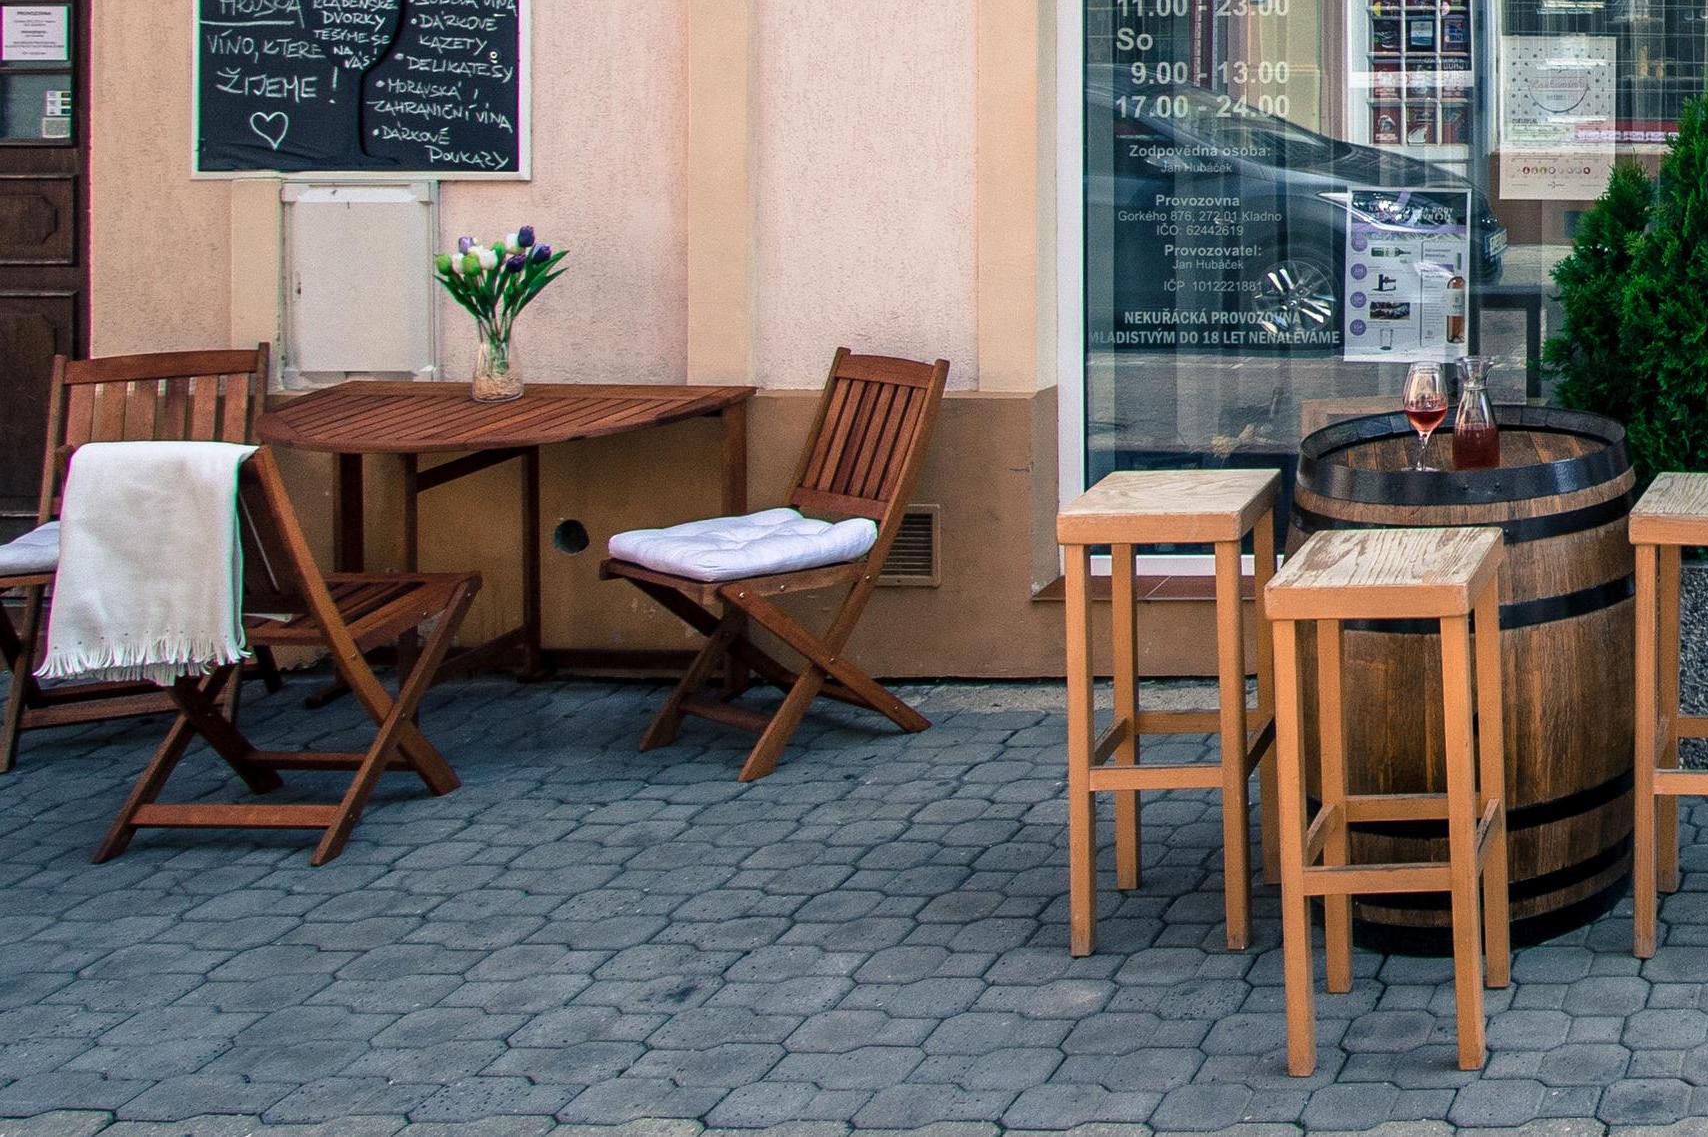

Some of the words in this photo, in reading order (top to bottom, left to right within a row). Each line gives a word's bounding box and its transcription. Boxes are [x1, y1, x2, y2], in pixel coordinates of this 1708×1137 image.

[322, 10, 386, 32] DVORKY
[371, 34, 391, 46] SE
[419, 35, 487, 56] KAZETY
[1116, 27, 1153, 51] So
[333, 45, 354, 55] NA
[406, 55, 514, 83] DELIKATESY
[1131, 62, 1188, 85] 9.00
[1217, 61, 1290, 84] 13.00
[1116, 95, 1188, 119] 17.00
[1215, 95, 1291, 118] 24.00
[1222, 145, 1271, 157] osoba:
[1155, 194, 1240, 207] Provozovna
[1118, 210, 1167, 224] Gorkého
[1242, 210, 1282, 222] Kladno
[1164, 244, 1262, 257] Provozovatel:
[1172, 261, 1192, 271] Jan
[1196, 259, 1244, 270] Hubáček
[1163, 279, 1184, 292] IČP
[1125, 307, 1207, 324] NEKUŘÁCKÁ
[1211, 310, 1301, 325] PROVOZOVNA
[1179, 330, 1199, 344] DO
[1203, 330, 1219, 344] 18
[1223, 330, 1244, 344] LET
